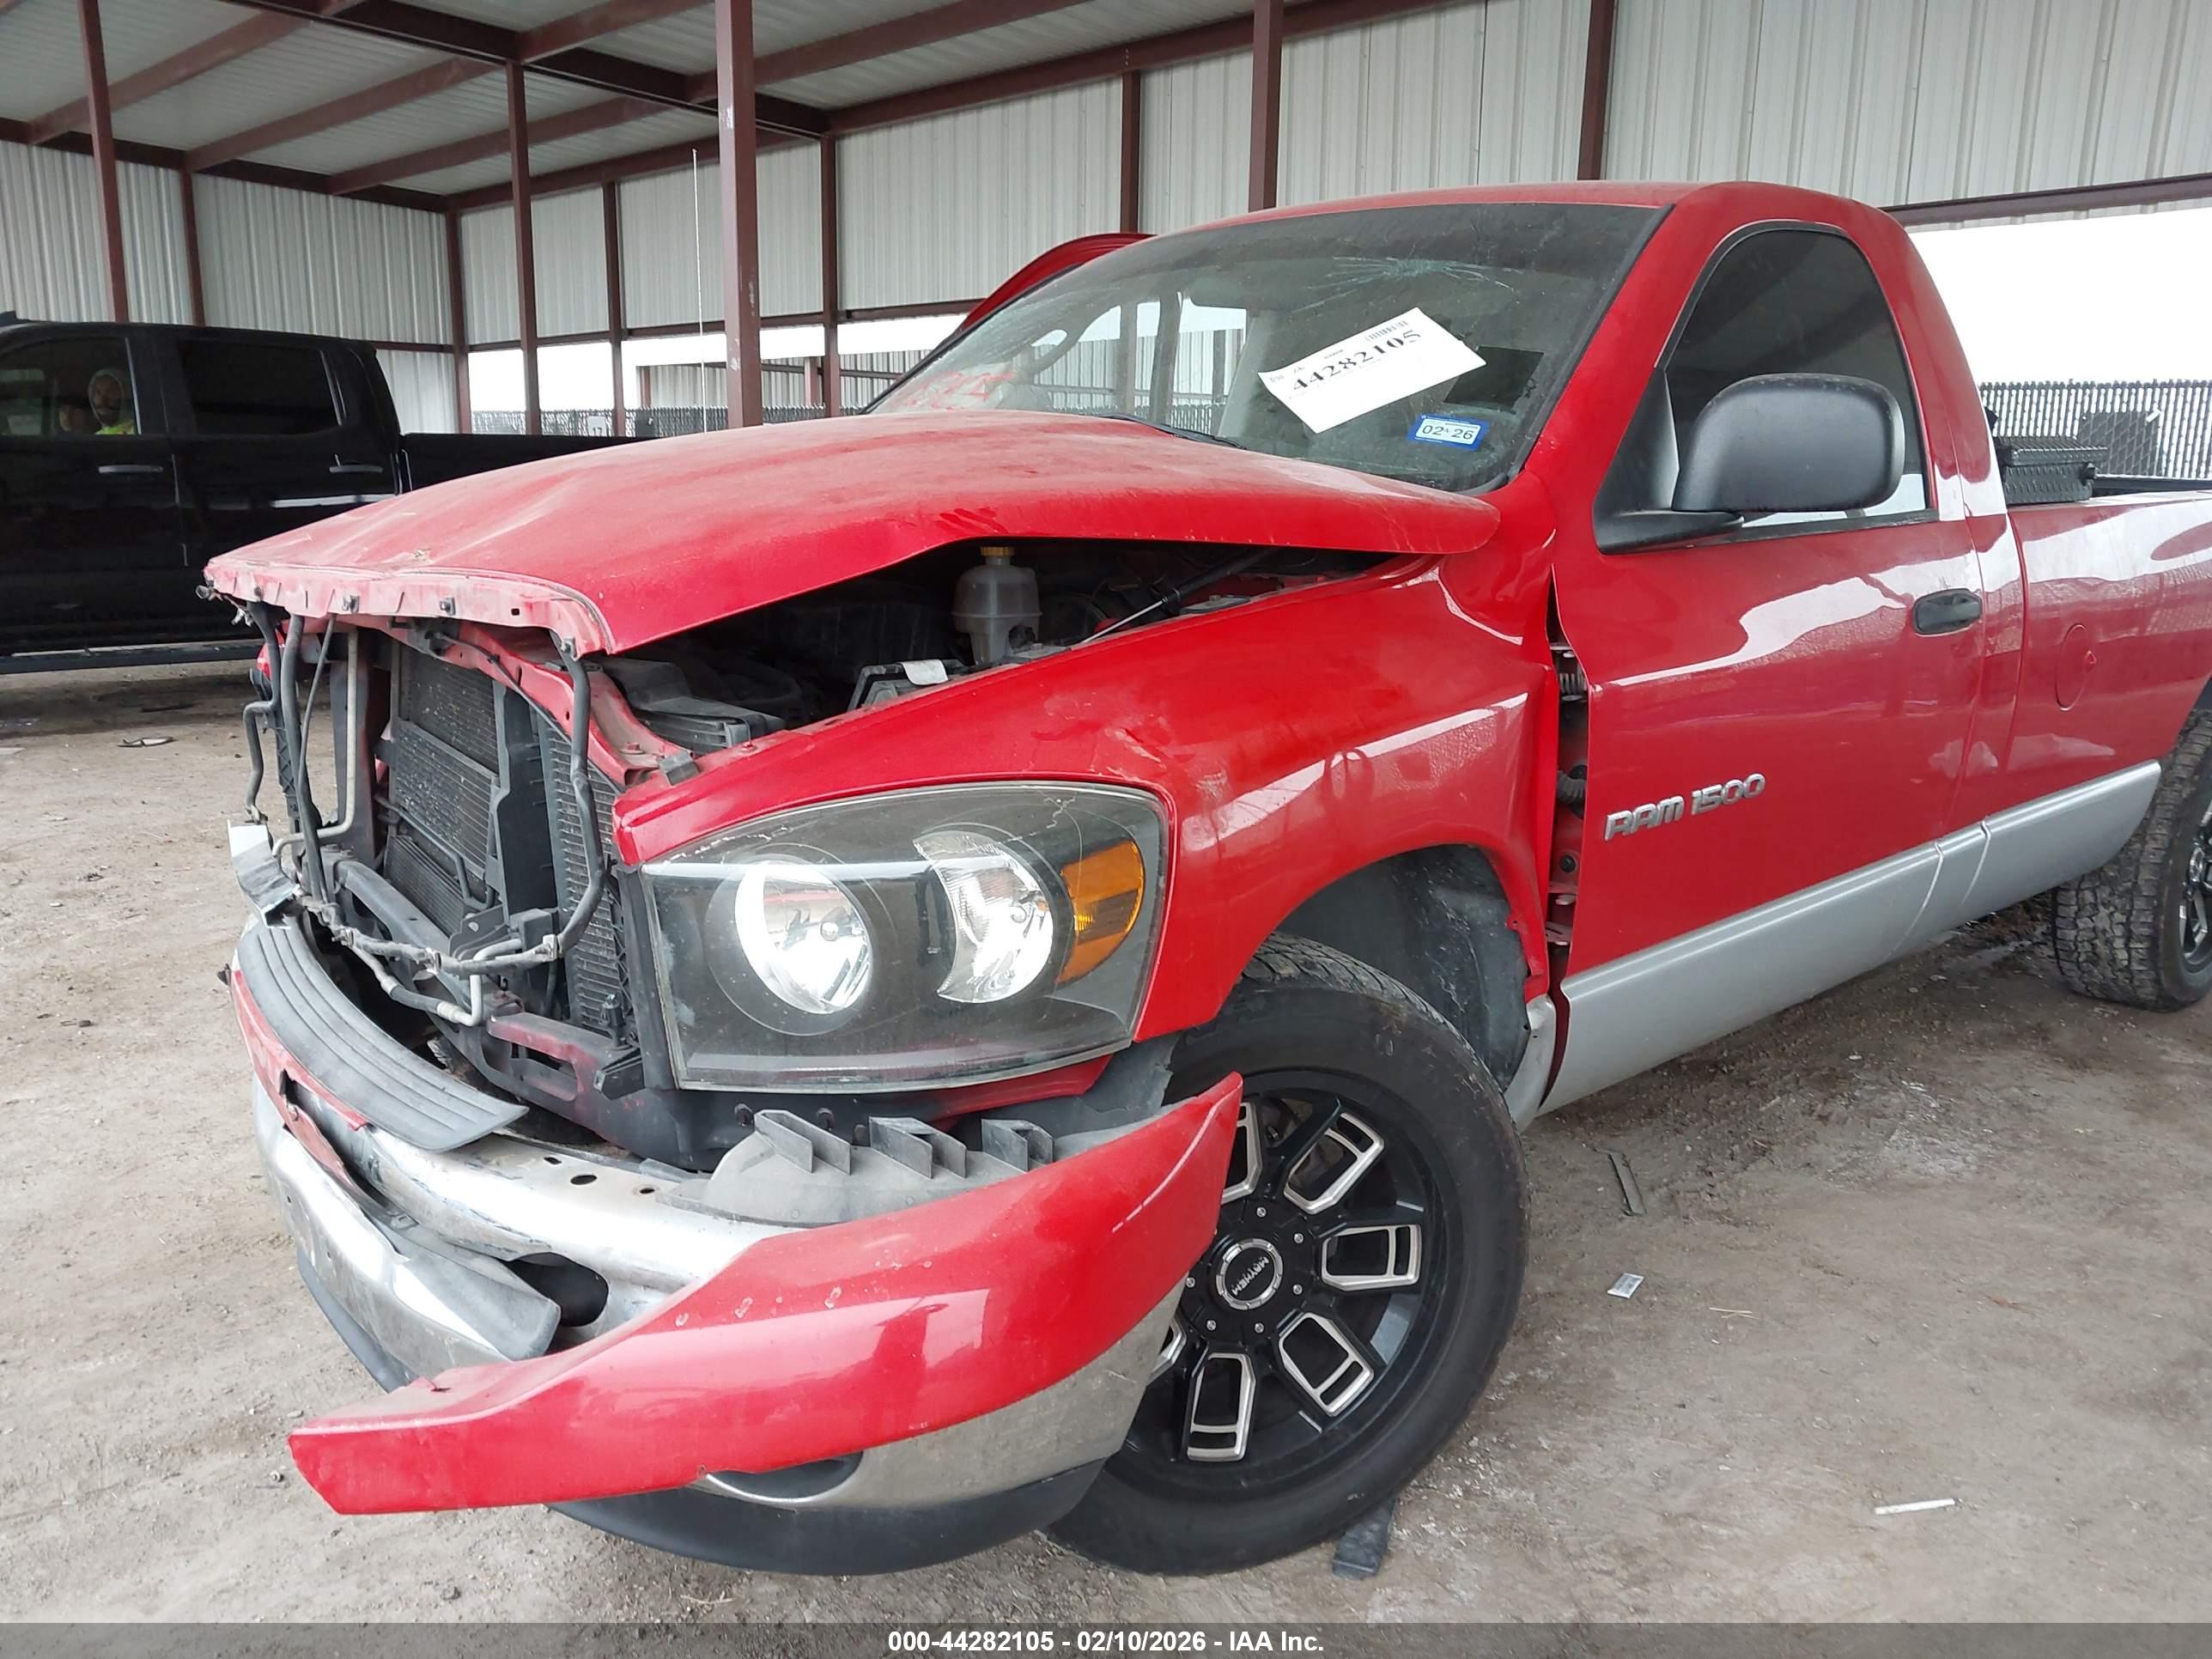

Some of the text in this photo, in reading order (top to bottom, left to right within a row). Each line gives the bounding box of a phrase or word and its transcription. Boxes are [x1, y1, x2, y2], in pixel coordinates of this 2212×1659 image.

[1292, 329, 1421, 391] 44282105
[1422, 424, 1444, 436] 02
[1450, 428, 1474, 440] 26
[1604, 773, 1766, 841] RAM 1500
[1231, 1256, 1270, 1296] MAYHEM
